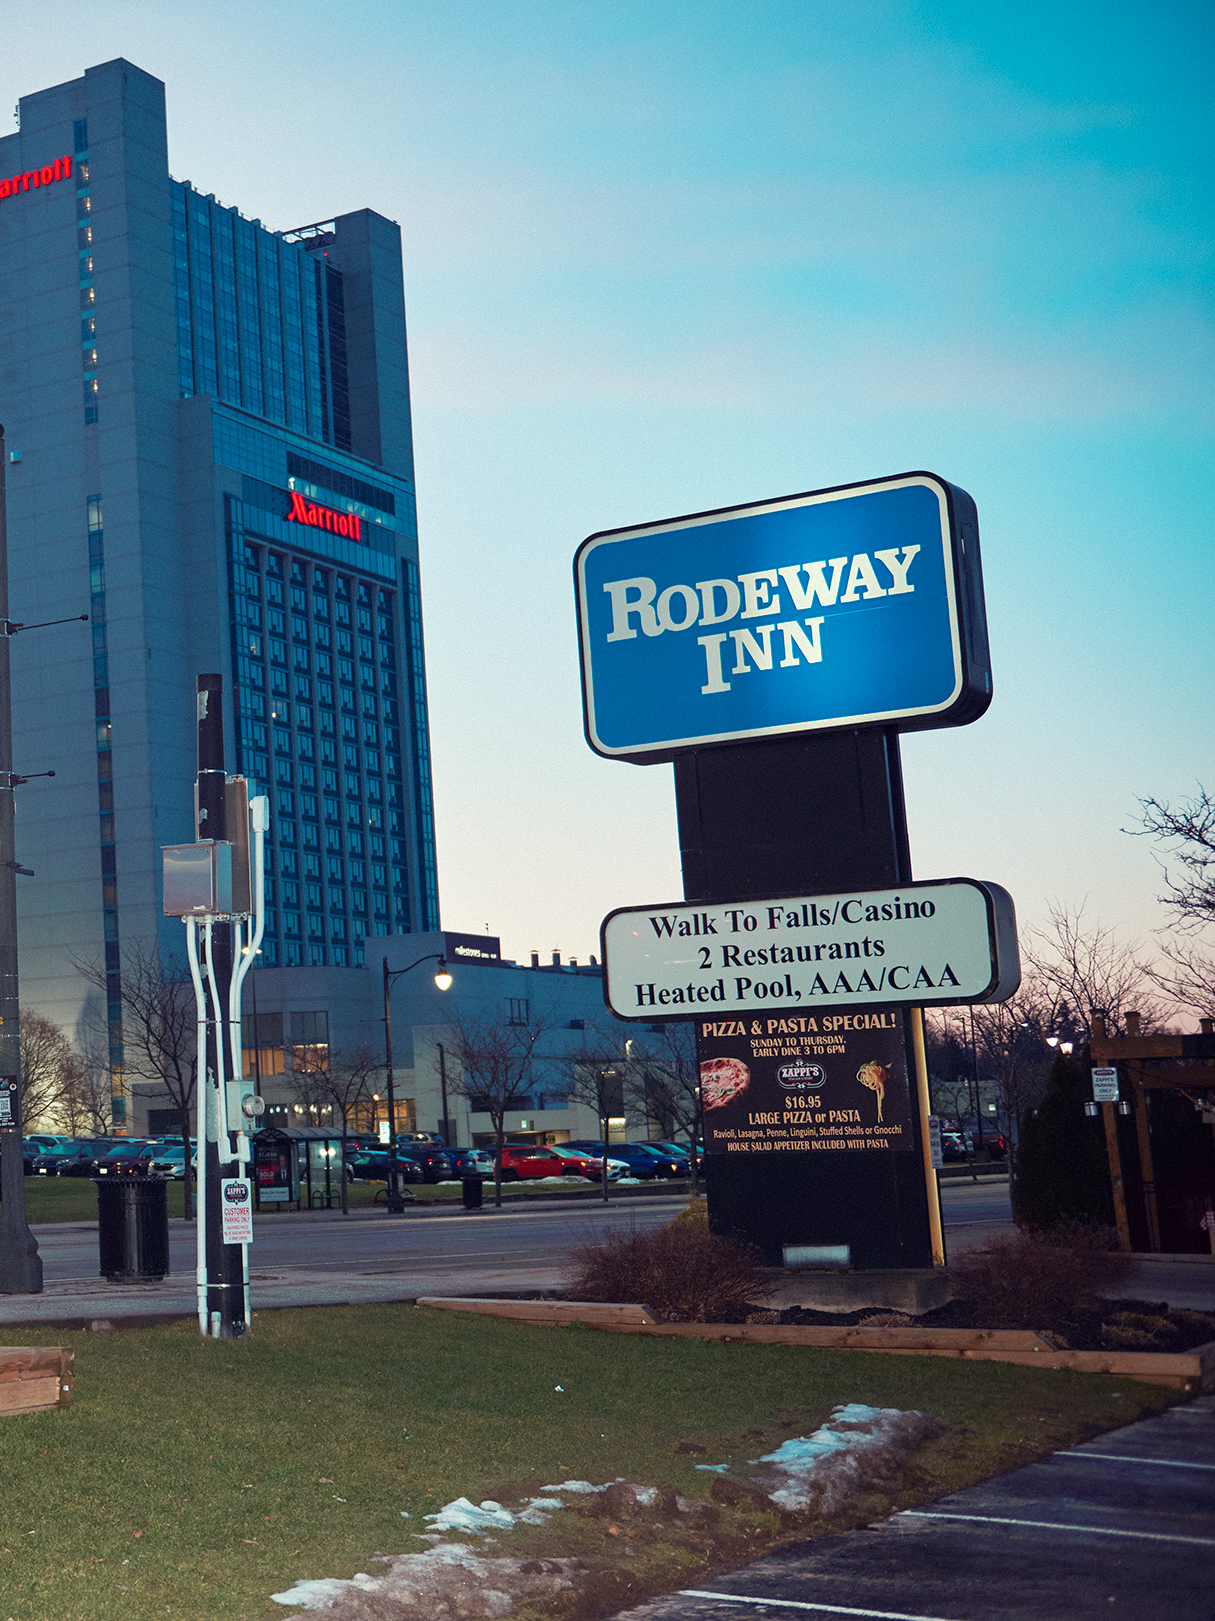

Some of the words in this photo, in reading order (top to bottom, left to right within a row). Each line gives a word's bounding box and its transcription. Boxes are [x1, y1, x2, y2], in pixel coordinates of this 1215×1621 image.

[287, 490, 361, 542] Marriott
[602, 544, 921, 643] RODEWAY
[697, 616, 825, 695] INN
[648, 913, 718, 939] Walk
[725, 910, 758, 933] To
[766, 896, 936, 931] Falls/Casino
[698, 947, 713, 969] 2
[720, 935, 885, 968] Restaurants
[635, 978, 726, 1007] Heated
[735, 974, 802, 1002] Pool,
[808, 962, 962, 996] AAA/CAA
[702, 1021, 746, 1037] PIZZA
[750, 1020, 762, 1035] &
[767, 1018, 818, 1034] PASTA
[822, 1013, 897, 1031] SPECIAL!
[750, 1038, 783, 1048] SUNDAY
[786, 1037, 797, 1047] TO
[799, 1035, 846, 1046] THURSDAY.
[753, 1047, 779, 1057] EARLY
[781, 1046, 802, 1056] DINE
[804, 1046, 810, 1055] 3
[813, 1045, 825, 1055] TO
[826, 1044, 845, 1054] 6PM
[781, 1066, 820, 1078] ZAPPI'S
[785, 1096, 821, 1109] $16.95
[748, 1113, 781, 1125] LARGE
[783, 1112, 812, 1124] PIZZA
[815, 1114, 826, 1124] or
[829, 1110, 861, 1123] PASTA
[713, 1129, 736, 1140] Ravioli,
[738, 1129, 765, 1140] Lasagna,
[766, 1128, 789, 1139] Penne,
[790, 1127, 818, 1139] Linguini,
[819, 1126, 843, 1136] Stuffed
[844, 1125, 864, 1135] Shells
[865, 1127, 873, 1135] or
[874, 1125, 902, 1135] Gnocchi
[727, 1142, 750, 1152] HOUSE
[751, 1141, 772, 1151] SALAD
[773, 1141, 810, 1151] APPETIZER
[811, 1140, 845, 1150] INCLUDED
[846, 1140, 865, 1149] WITH
[866, 1139, 889, 1148] PASTA
[224, 1207, 250, 1216] CUSTOMER
